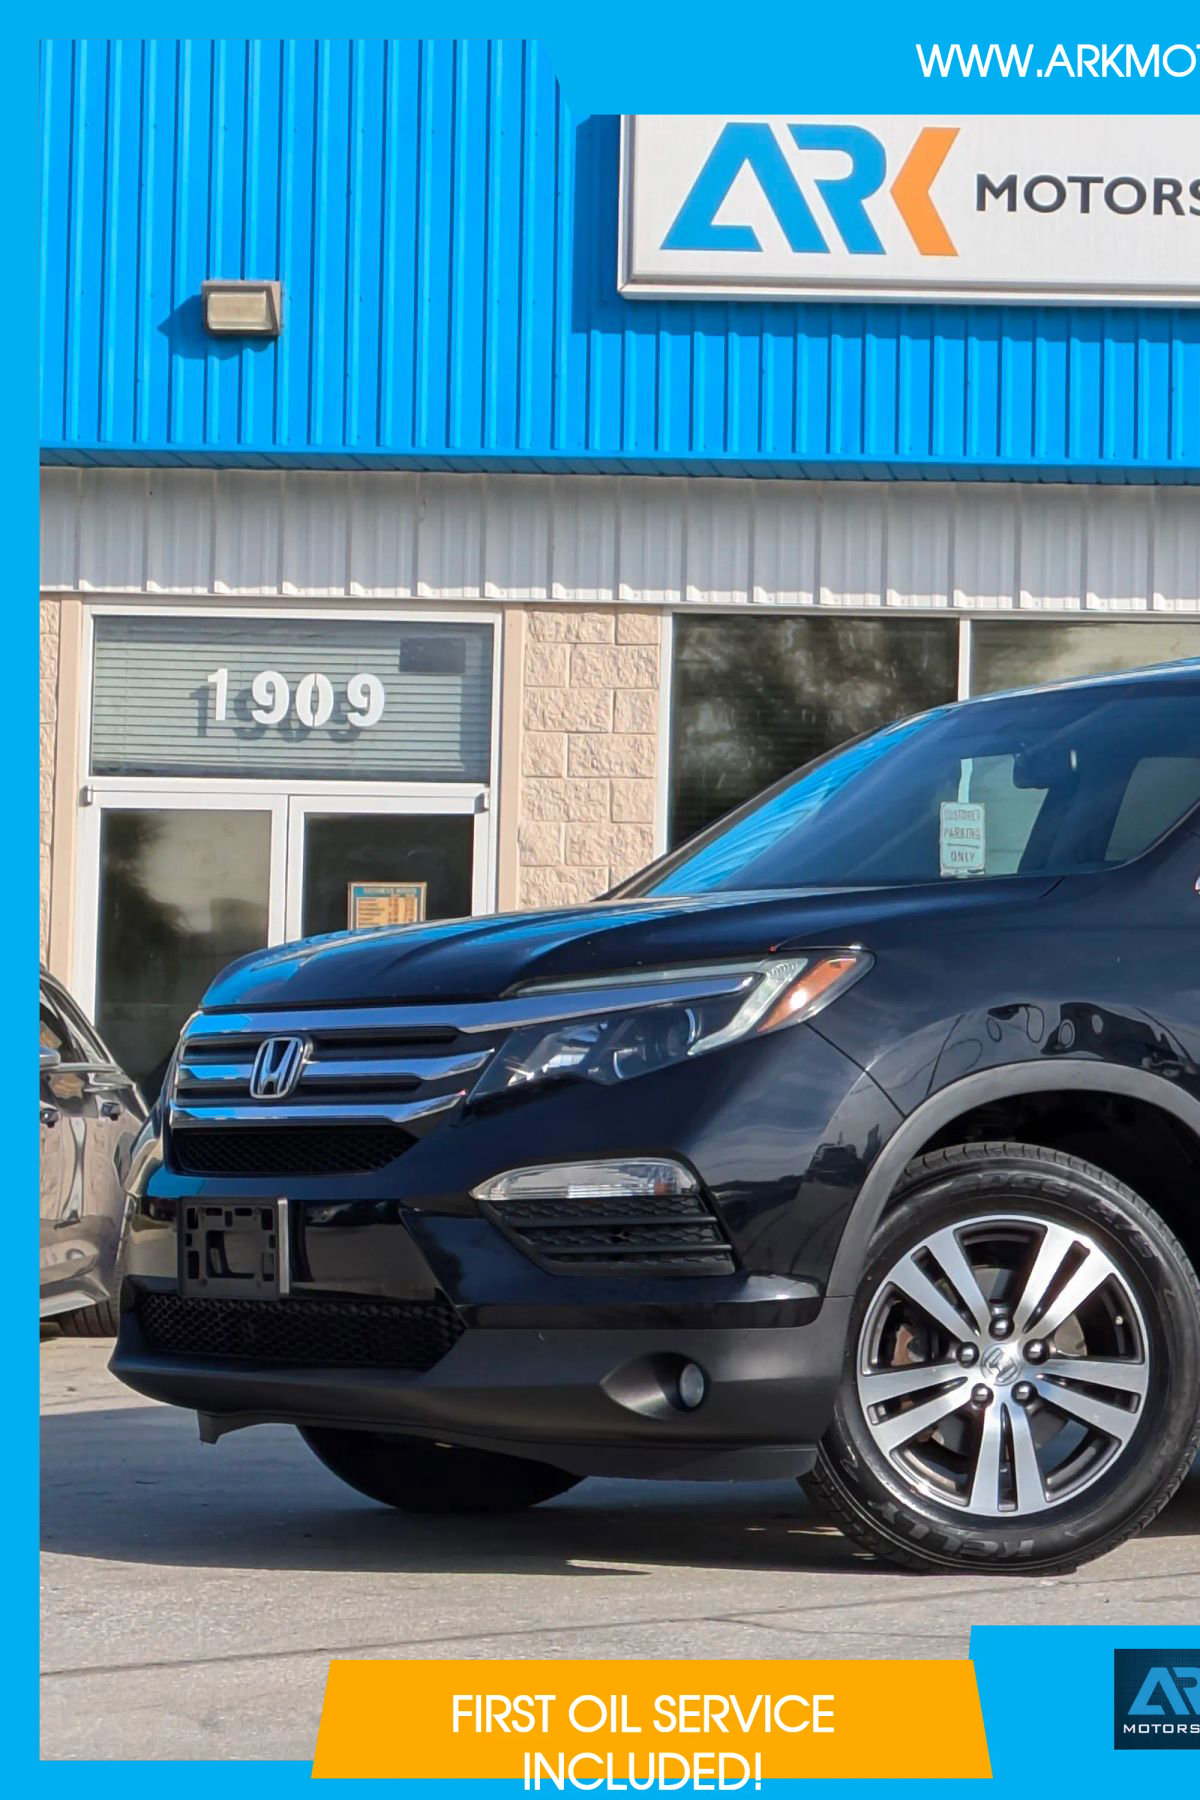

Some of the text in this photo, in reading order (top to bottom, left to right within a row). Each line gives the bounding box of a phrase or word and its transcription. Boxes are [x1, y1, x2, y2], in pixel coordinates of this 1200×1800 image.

[660, 122, 961, 257] ARK
[207, 667, 385, 727] 1909
[950, 850, 976, 863] ONLY
